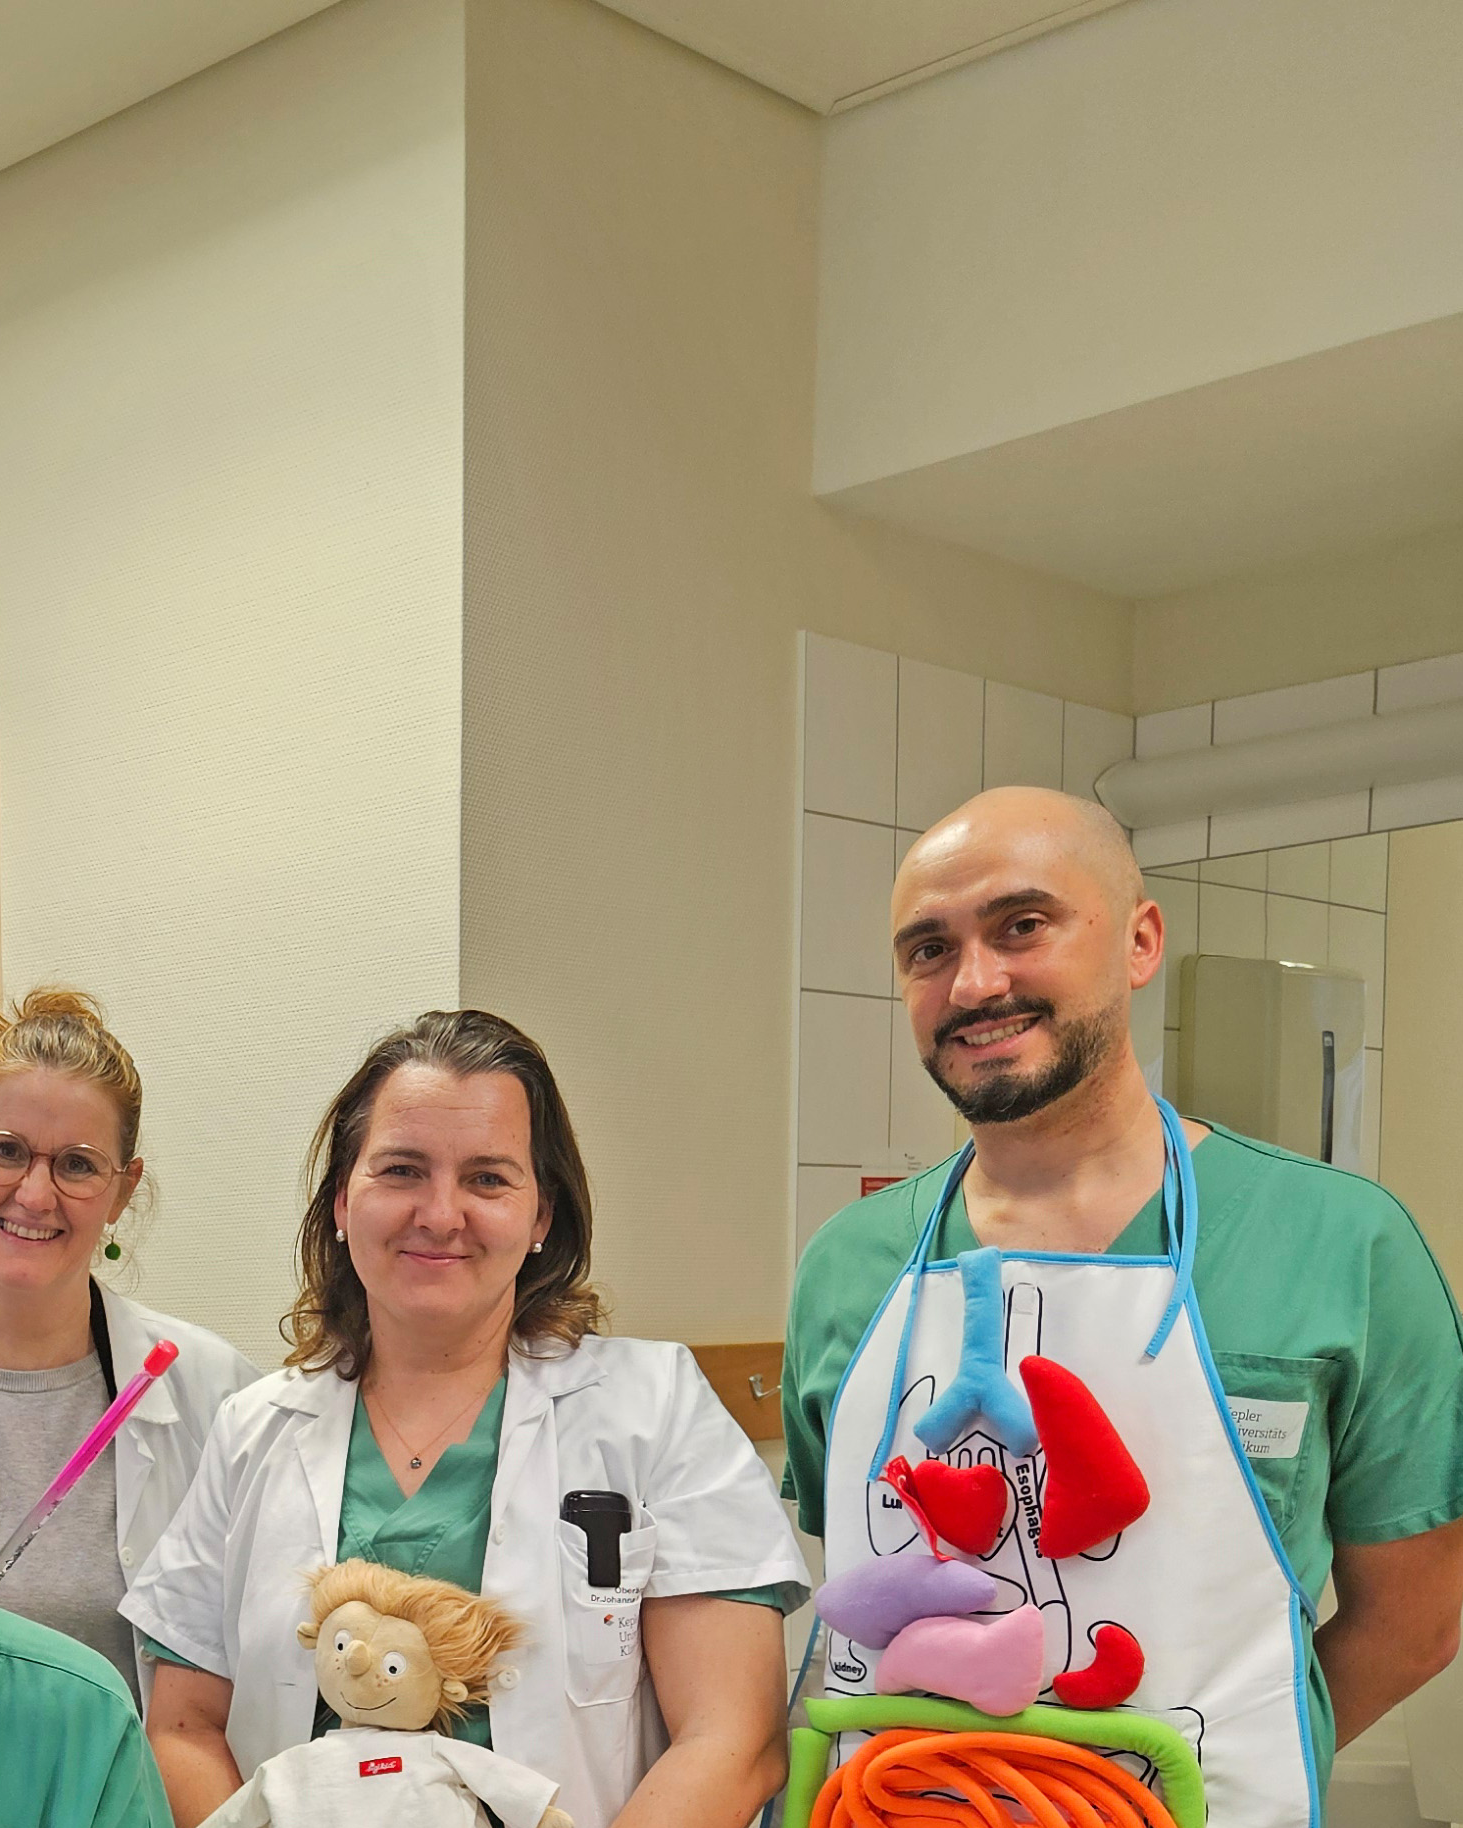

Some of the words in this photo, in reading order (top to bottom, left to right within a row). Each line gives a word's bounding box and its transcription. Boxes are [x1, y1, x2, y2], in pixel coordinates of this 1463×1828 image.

[1228, 1407, 1262, 1423] epler
[1237, 1425, 1287, 1439] iversitäts
[1243, 1441, 1270, 1453] ikum
[834, 1662, 863, 1676] kidney
